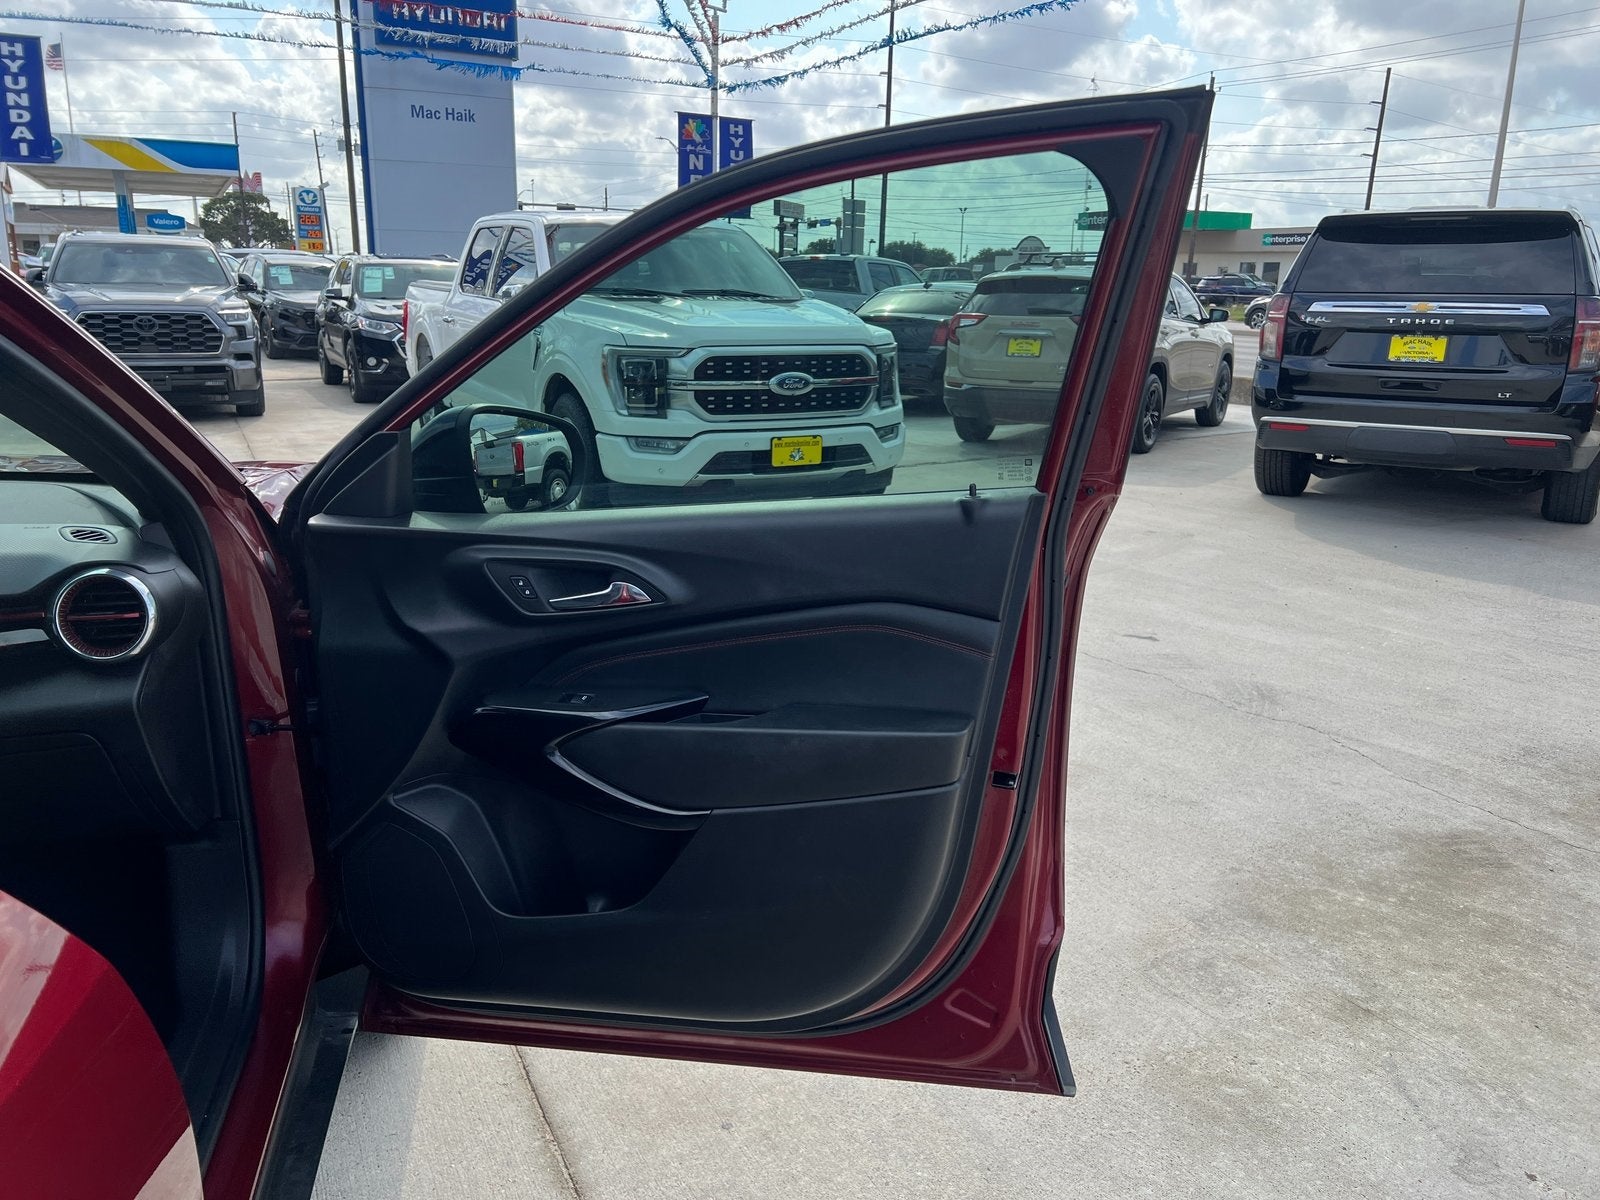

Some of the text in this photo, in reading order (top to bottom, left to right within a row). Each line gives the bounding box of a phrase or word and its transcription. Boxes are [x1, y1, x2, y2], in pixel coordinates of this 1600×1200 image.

[0, 42, 35, 156] HYUNDAI
[410, 104, 476, 123] Mac Haik
[729, 123, 745, 167] HYU
[152, 217, 180, 226] Valero
[1263, 234, 1307, 245] enterprise
[1386, 317, 1456, 325] TAHOE
[1402, 338, 1417, 347] MAC
[782, 378, 806, 389] Ford
